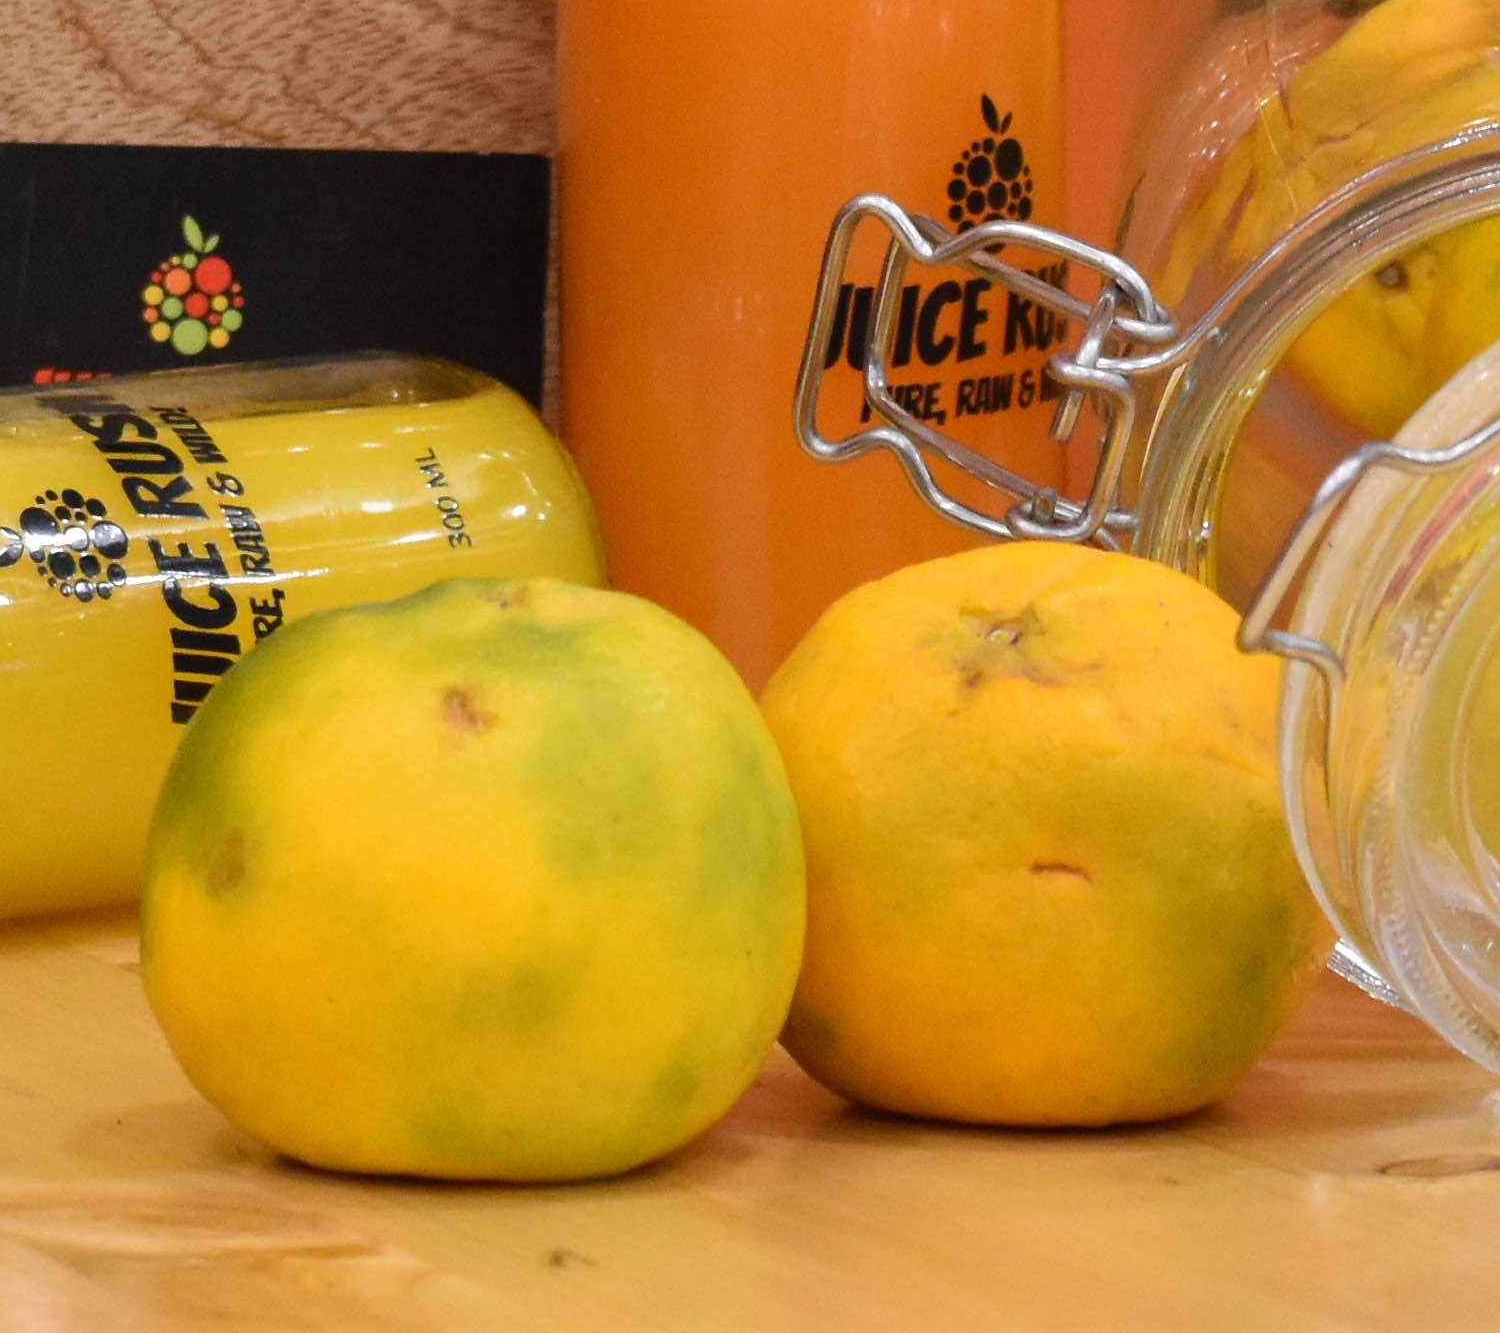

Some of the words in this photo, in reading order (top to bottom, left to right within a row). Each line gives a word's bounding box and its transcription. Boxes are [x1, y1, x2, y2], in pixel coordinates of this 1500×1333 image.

[955, 373, 1016, 418] RAW
[1018, 368, 1035, 409] &
[150, 406, 228, 463] WILD!
[206, 471, 244, 498] &
[415, 447, 448, 489] ML
[220, 504, 277, 576] RAW
[437, 496, 472, 548] 300
